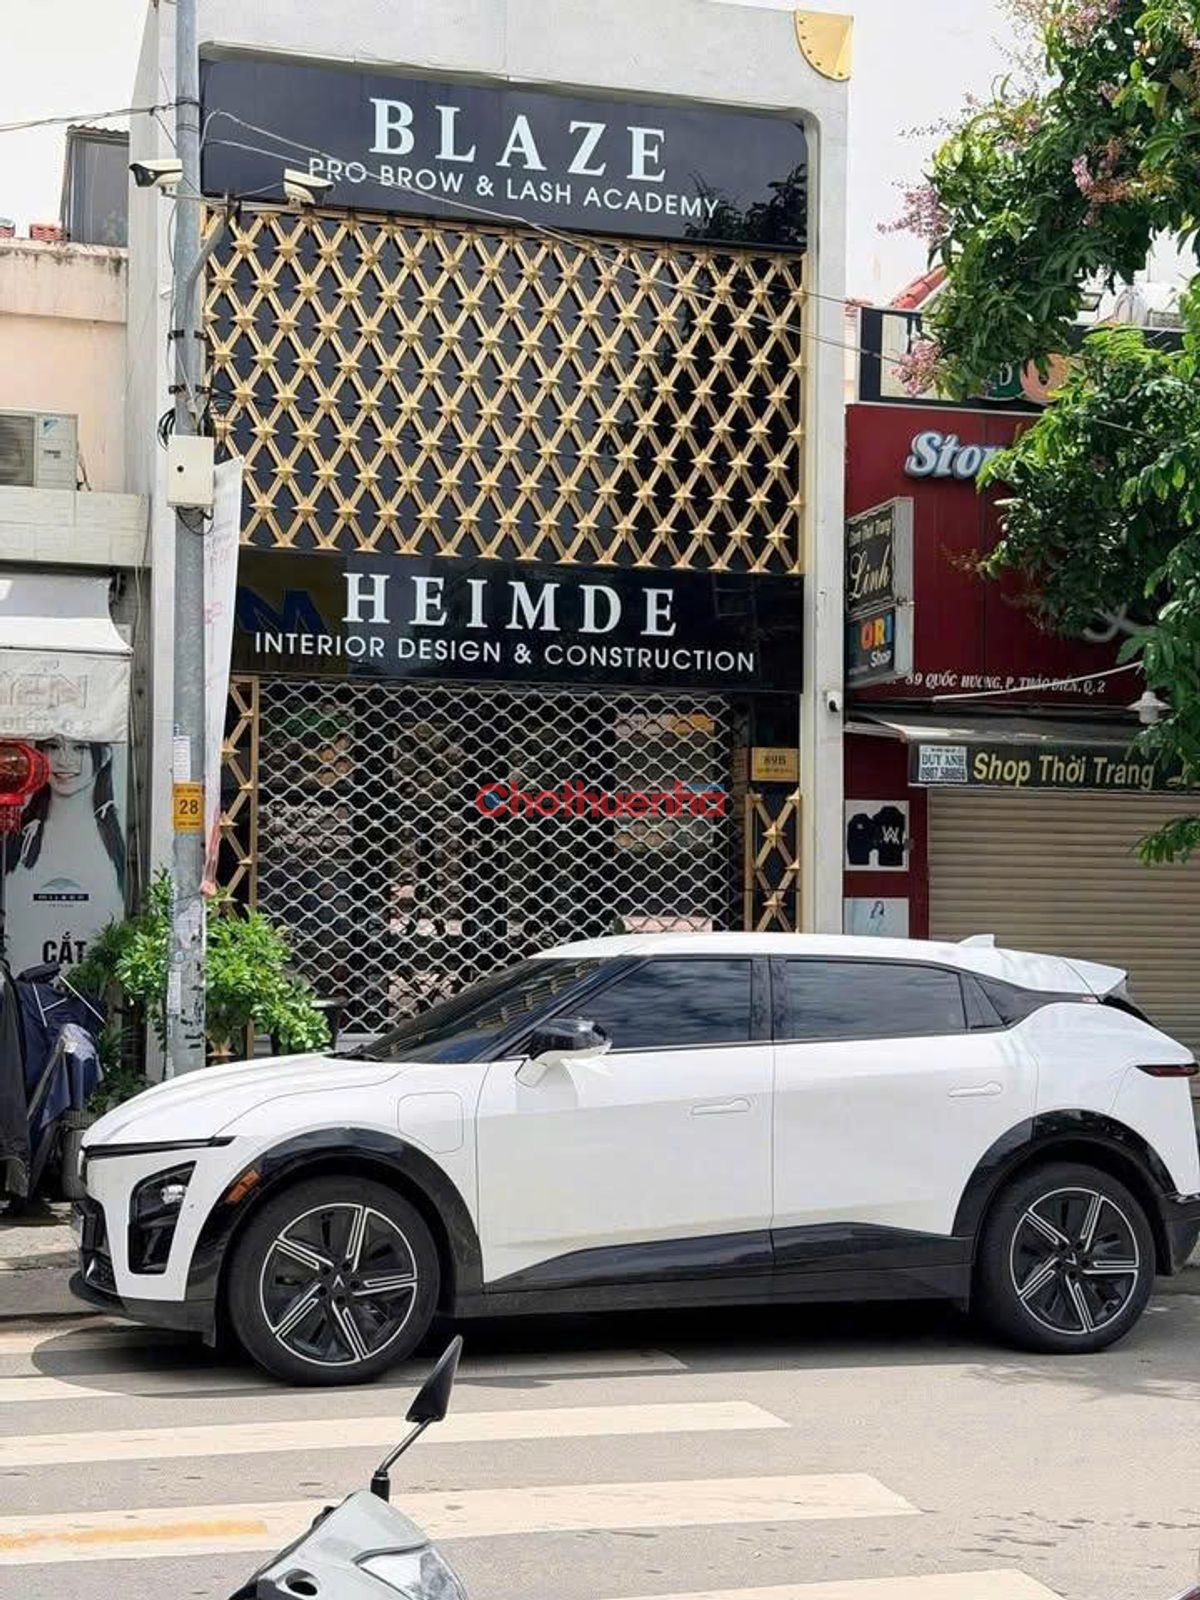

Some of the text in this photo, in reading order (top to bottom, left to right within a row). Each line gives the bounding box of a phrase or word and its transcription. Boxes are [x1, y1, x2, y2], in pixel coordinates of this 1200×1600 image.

[368, 97, 667, 183] BLAZE
[308, 157, 720, 218] PRO BROW & LASH ACADEMY
[341, 572, 678, 637] HEIMDE
[255, 630, 755, 673] INTERIOR DESIGN & CONSTRUCTION
[973, 751, 1032, 788] Shop
[1039, 754, 1088, 784] Thời
[1093, 756, 1156, 789] Trang
[178, 799, 199, 815] 28
[42, 931, 88, 965] CẮT
